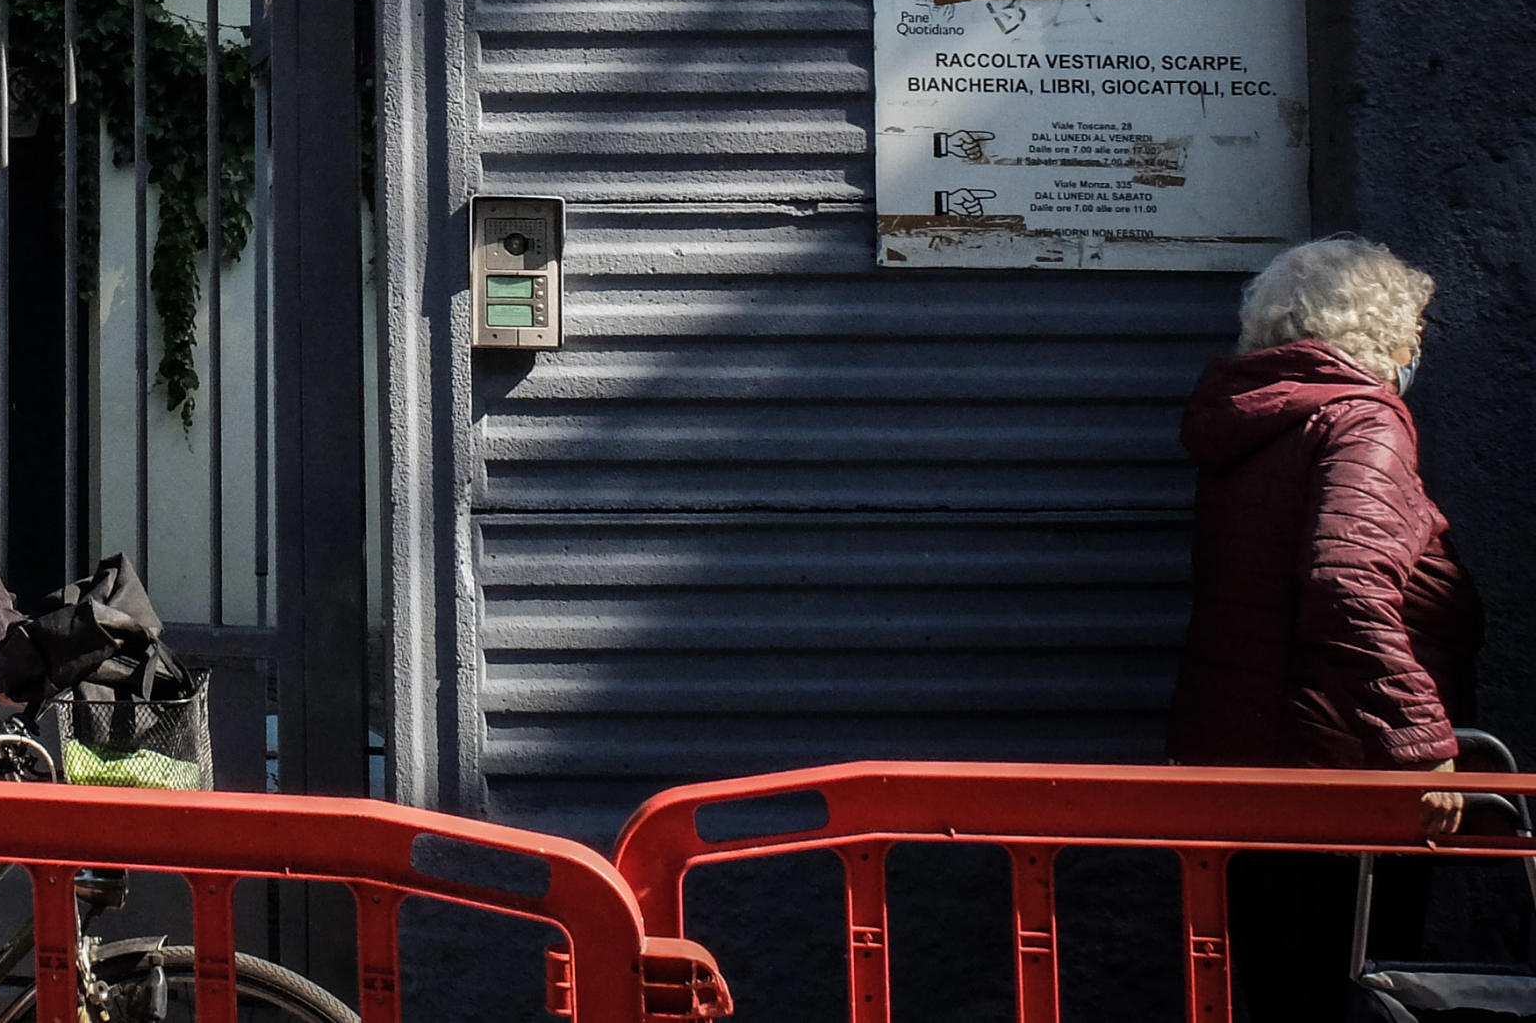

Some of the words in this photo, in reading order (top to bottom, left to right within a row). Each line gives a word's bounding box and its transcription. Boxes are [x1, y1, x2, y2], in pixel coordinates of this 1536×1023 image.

[901, 11, 929, 23] Pane
[897, 23, 965, 36] Quotidiano
[936, 53, 1041, 68] RACCOLTA
[1045, 54, 1155, 72] VESTIARIO,
[1161, 55, 1247, 73] SCARPE,
[908, 77, 1034, 96] BIANCHERIA,
[1040, 79, 1096, 97] LIBRI,
[1102, 79, 1224, 98] GIOCATTOLI,
[1231, 80, 1277, 96] ECC.
[1051, 122, 1074, 130] Viale
[1032, 133, 1051, 141] DAL
[1092, 134, 1106, 142] AL
[1029, 145, 1052, 153] Dalle
[1073, 145, 1092, 153] 7.00
[1095, 146, 1111, 154] alle
[1054, 180, 1077, 189] Viale
[1034, 192, 1054, 201] DAL
[1095, 192, 1109, 201] AL
[1111, 192, 1153, 201] SABATO
[1030, 204, 1053, 212] Dalle
[1075, 204, 1094, 212] 7.00
[1096, 205, 1113, 213] alle
[1134, 205, 1158, 213] 11.00
[1092, 229, 1113, 237] NON
